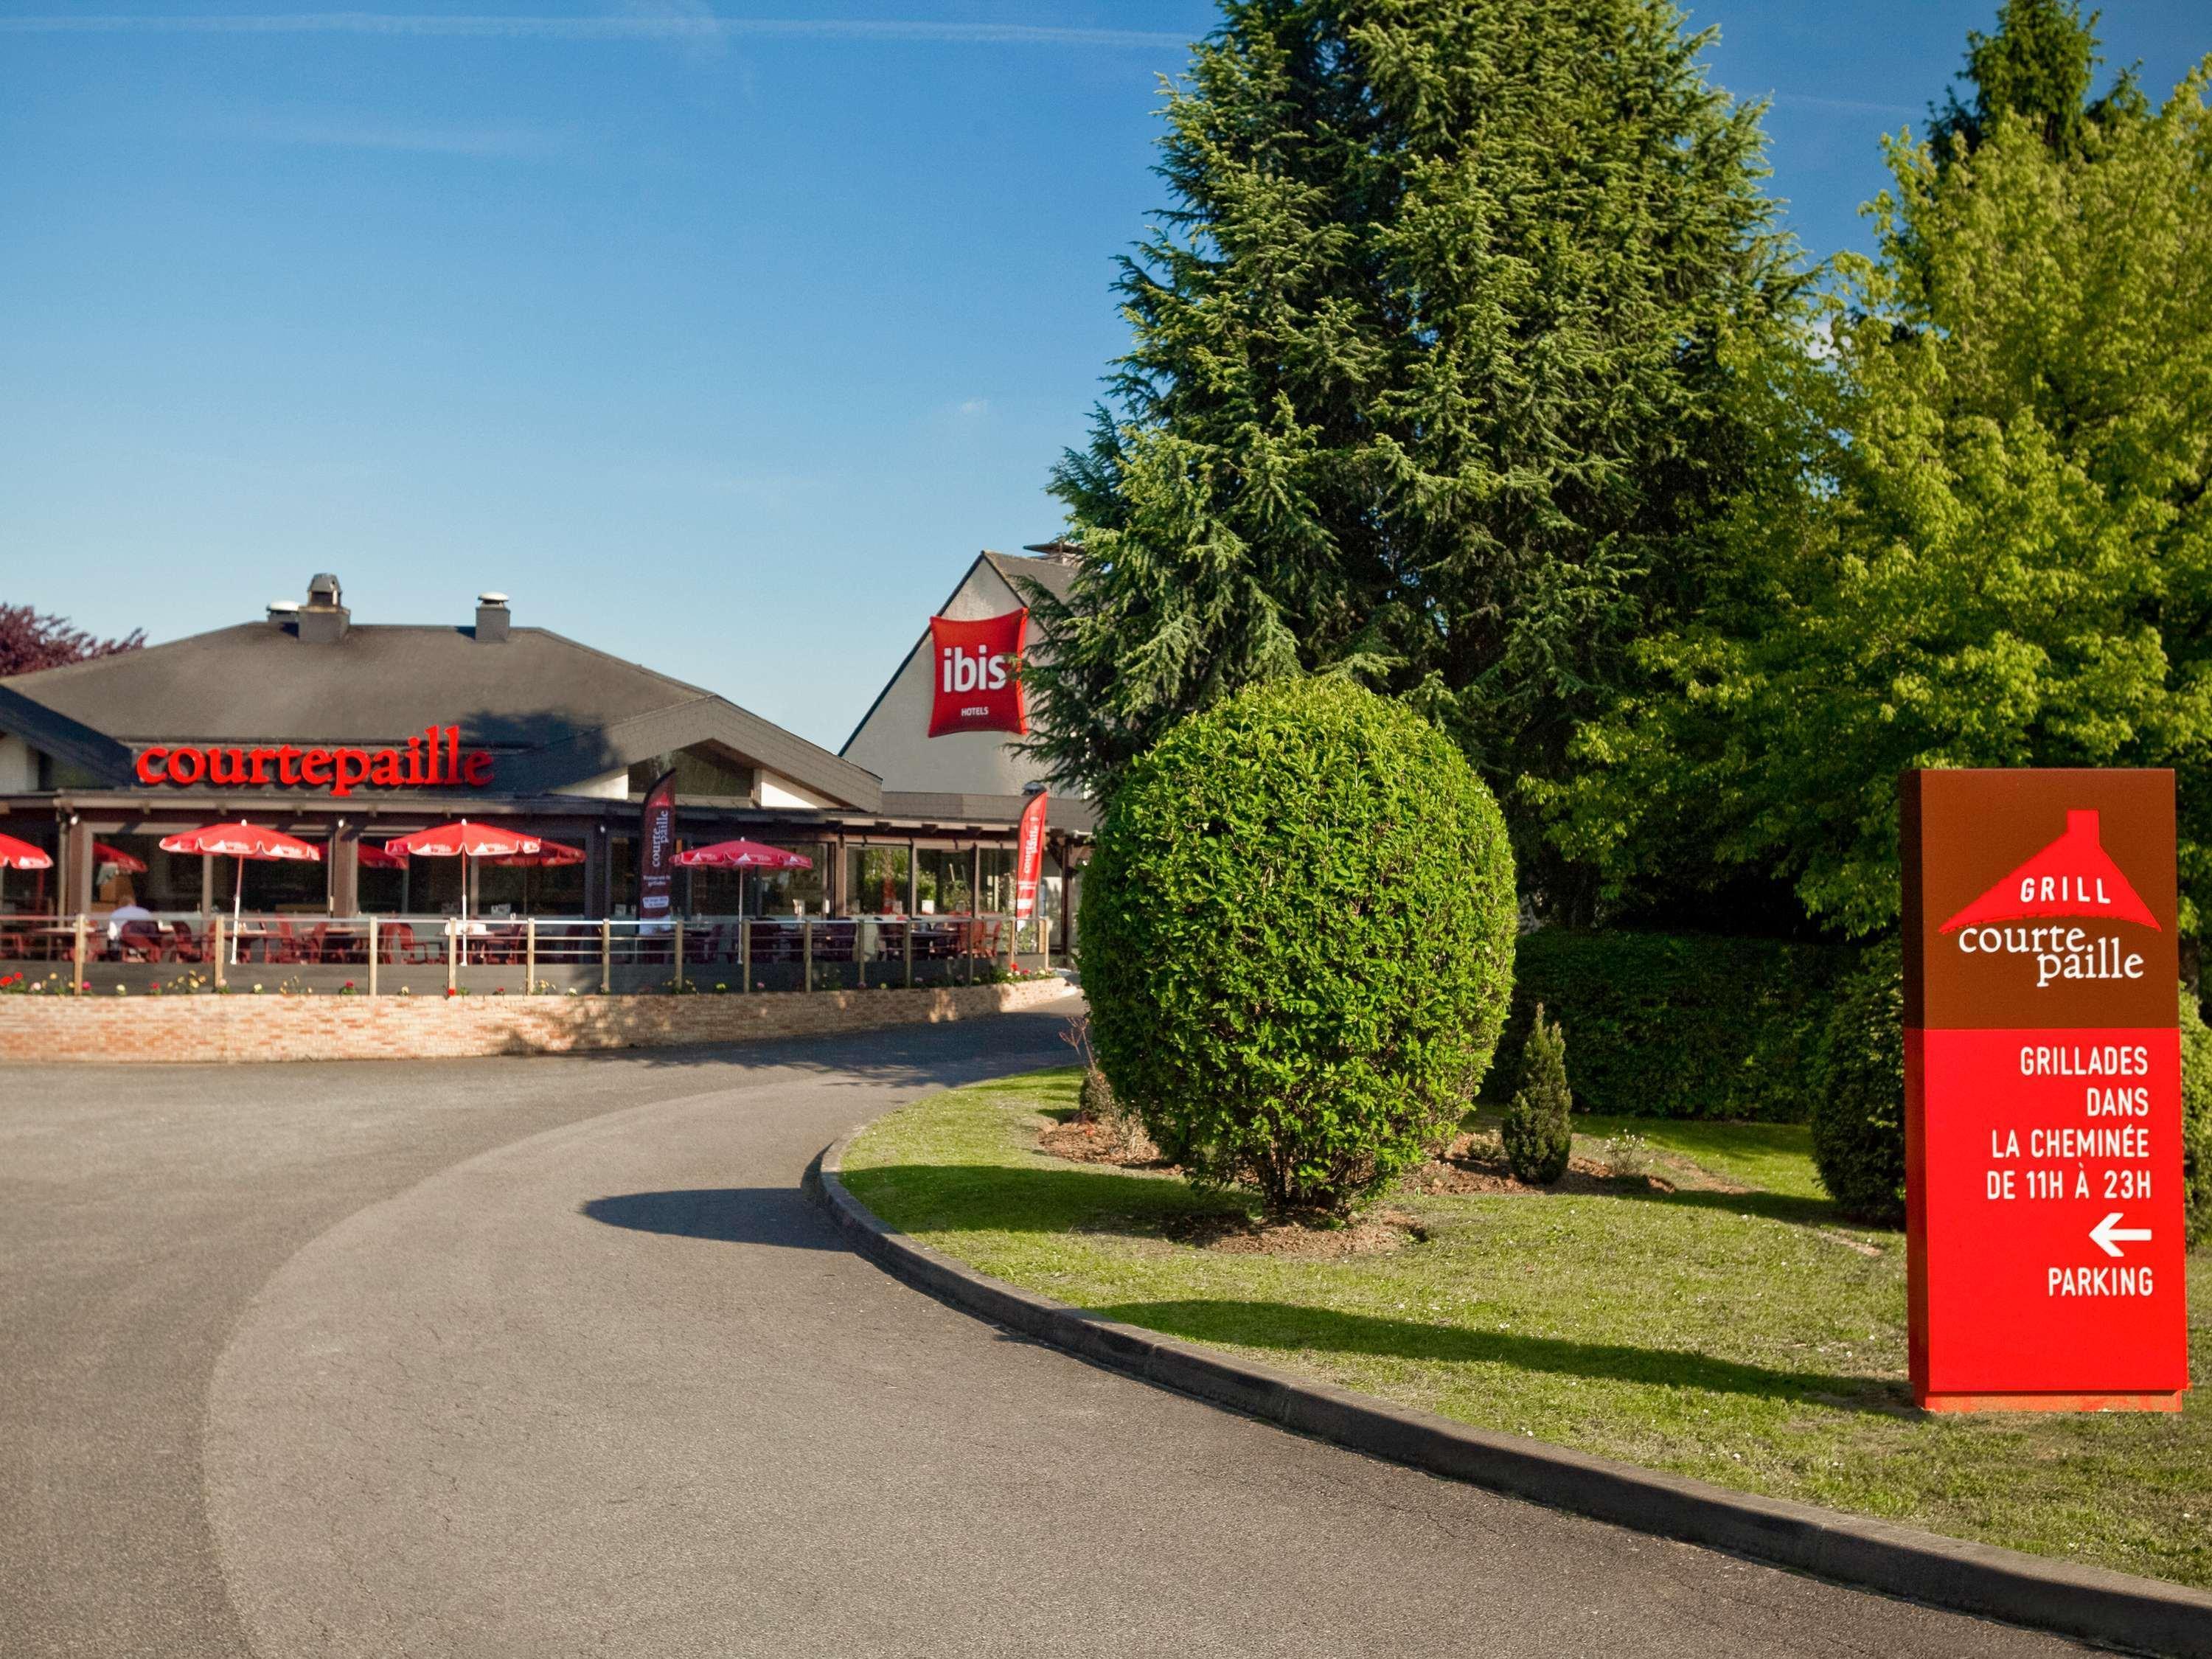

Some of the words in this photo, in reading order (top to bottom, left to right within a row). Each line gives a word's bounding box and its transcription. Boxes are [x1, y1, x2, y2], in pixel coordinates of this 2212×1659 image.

[943, 644, 1007, 693] ibis
[961, 706, 989, 717] HOTELS
[136, 726, 493, 796] courtepaille
[653, 827, 661, 867] courte
[2020, 876, 2111, 904] GRILL
[1958, 925, 2086, 953] courte
[2037, 937, 2144, 987] paille
[2020, 1046, 2148, 1076] GRILLADES
[2087, 1087, 2149, 1117] DANS
[1992, 1129, 2020, 1158] LA
[2031, 1124, 2149, 1158] CHEMINÉE
[1986, 1170, 2016, 1200] DE
[2025, 1170, 2063, 1199] 11H
[2075, 1162, 2090, 1199] À
[2104, 1169, 2151, 1199] 23H
[2048, 1267, 2153, 1296] PARKING
